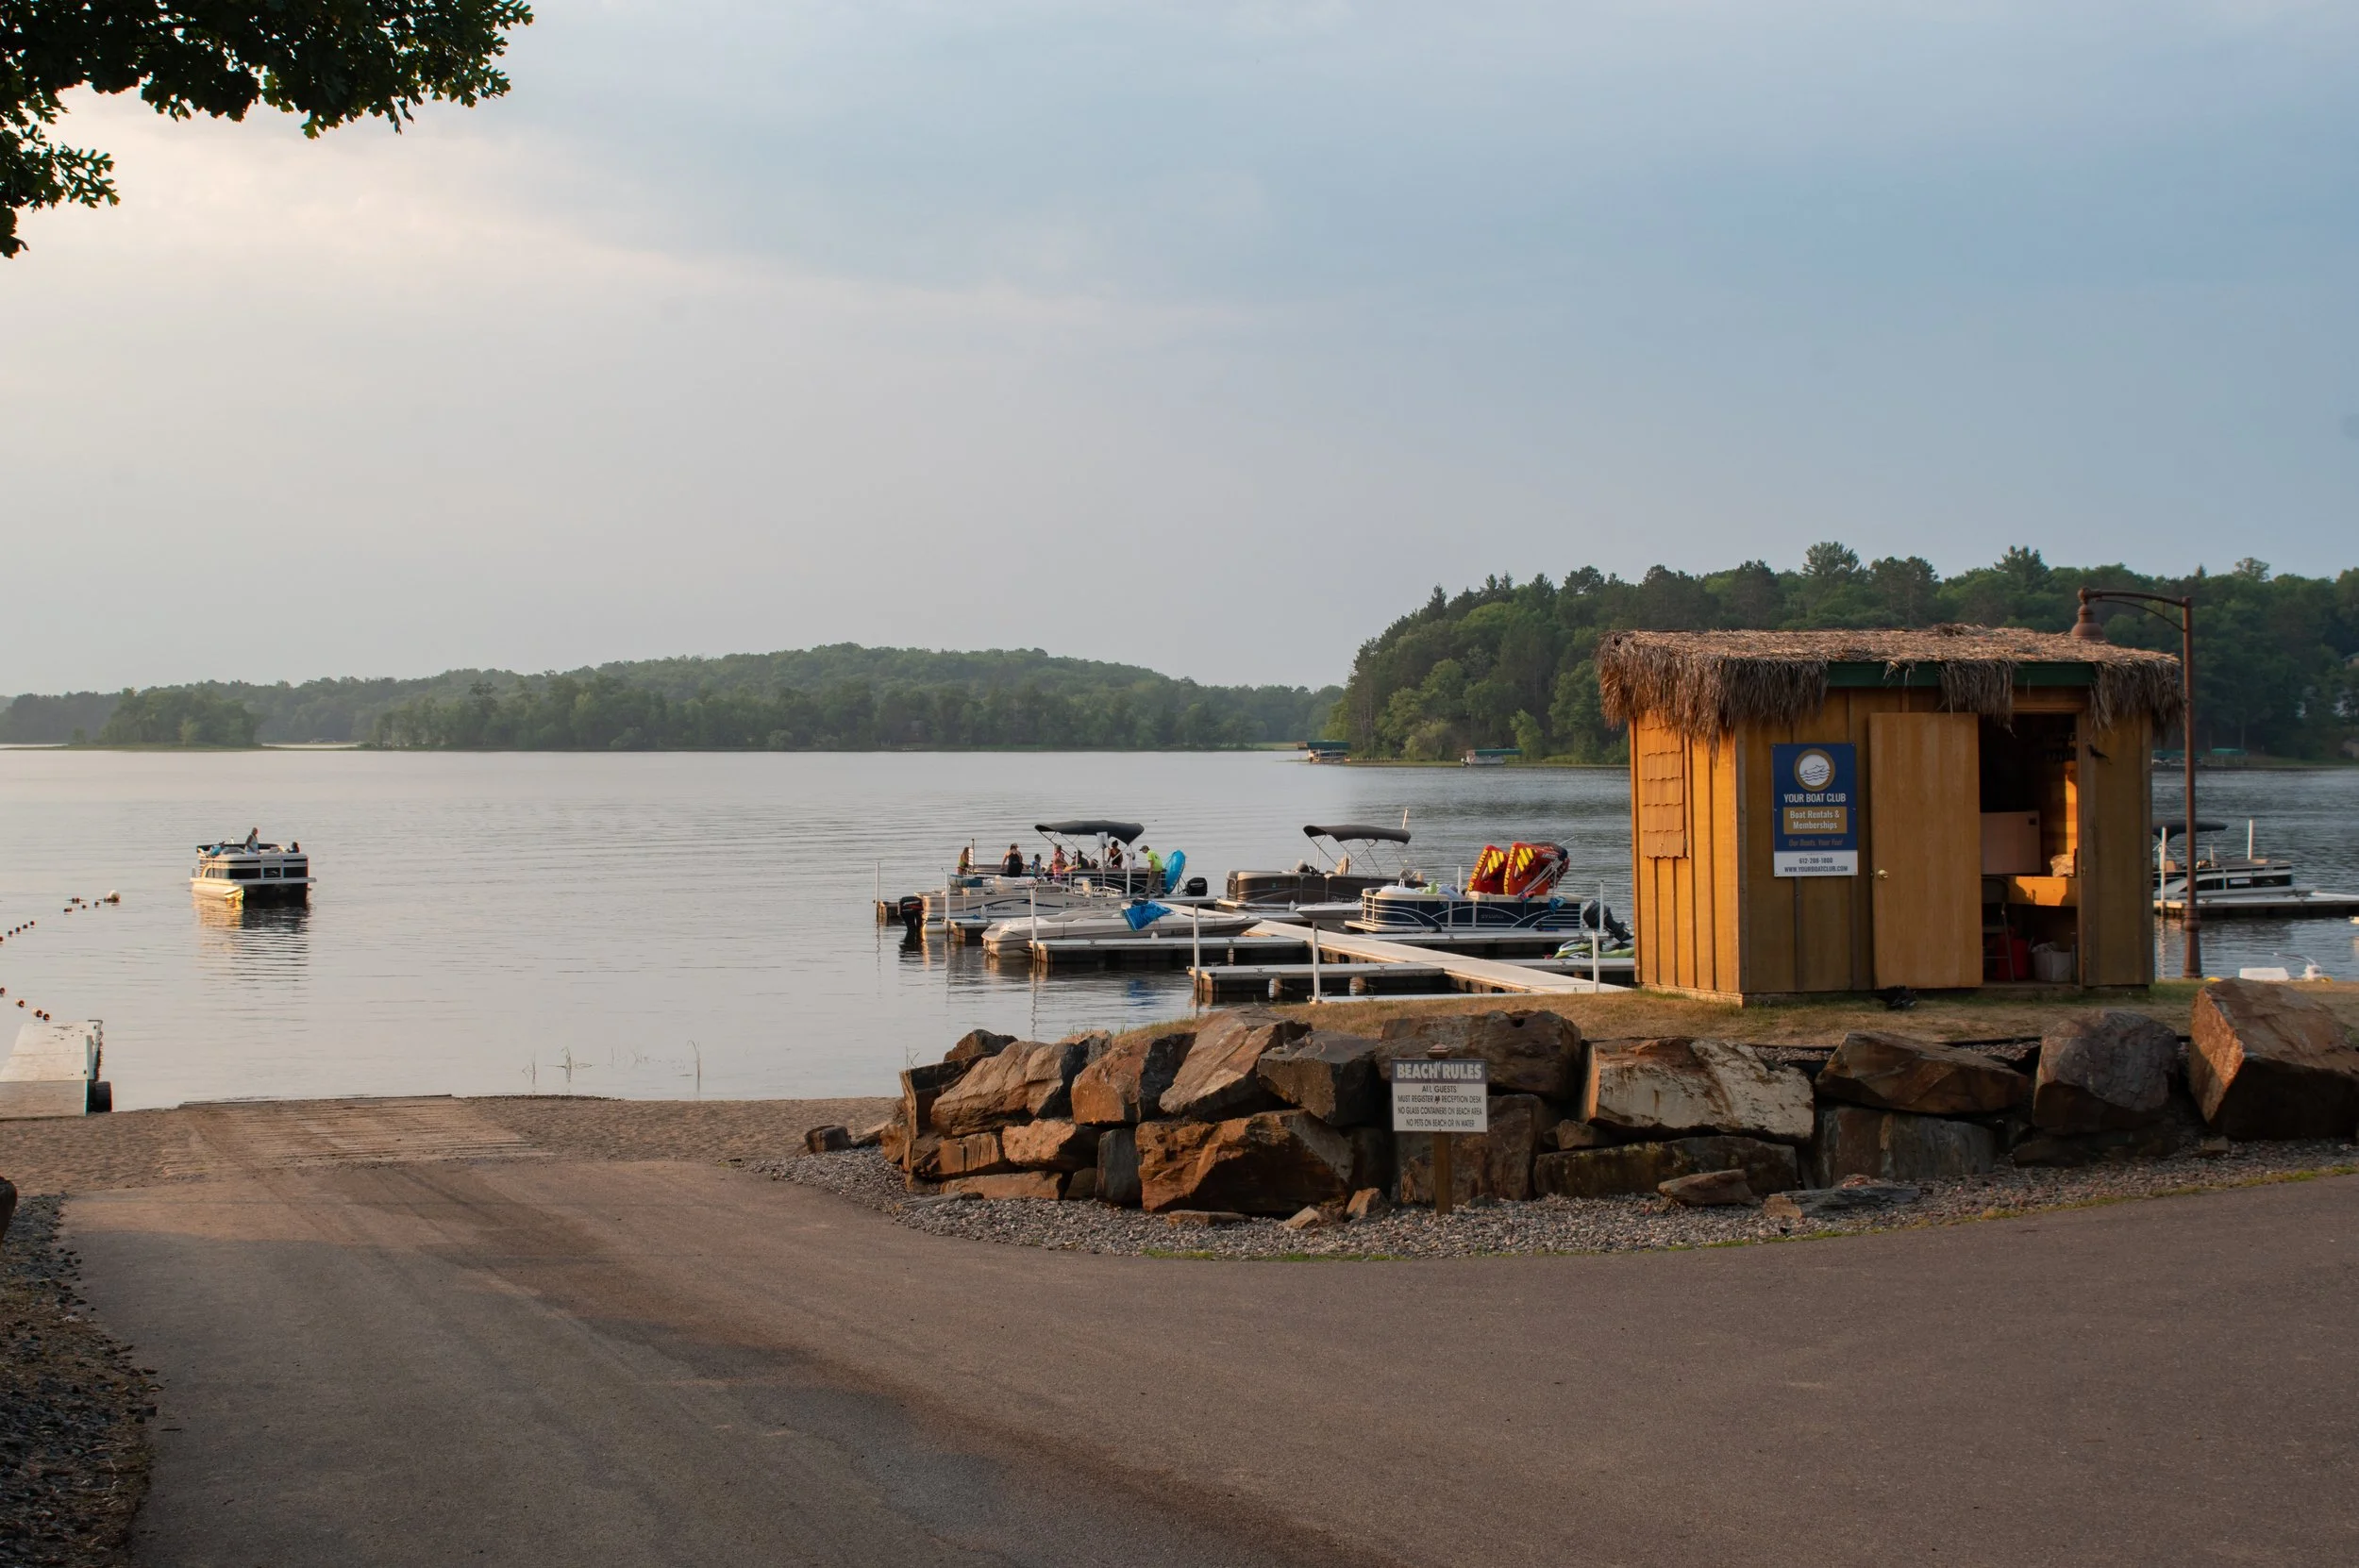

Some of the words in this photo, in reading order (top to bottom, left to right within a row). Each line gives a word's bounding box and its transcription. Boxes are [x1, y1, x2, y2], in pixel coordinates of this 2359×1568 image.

[1783, 793, 1804, 803] YOUR
[1806, 793, 1825, 802] BOAT
[1826, 792, 1847, 802] CLUB
[1790, 810, 1806, 819] Boat
[1807, 809, 1833, 819] Rentals
[1834, 809, 1840, 818] &
[1793, 821, 1838, 830] Memberships
[1397, 1063, 1437, 1079] BEACH
[1442, 1063, 1482, 1080] RULES
[1421, 1085, 1432, 1093] ALL
[1434, 1085, 1457, 1093] GUESTS
[1441, 1095, 1468, 1104] RECEPTION
[1469, 1095, 1481, 1104] DESK
[1406, 1107, 1419, 1115] GLASS
[1420, 1107, 1447, 1115] CONTAINERS
